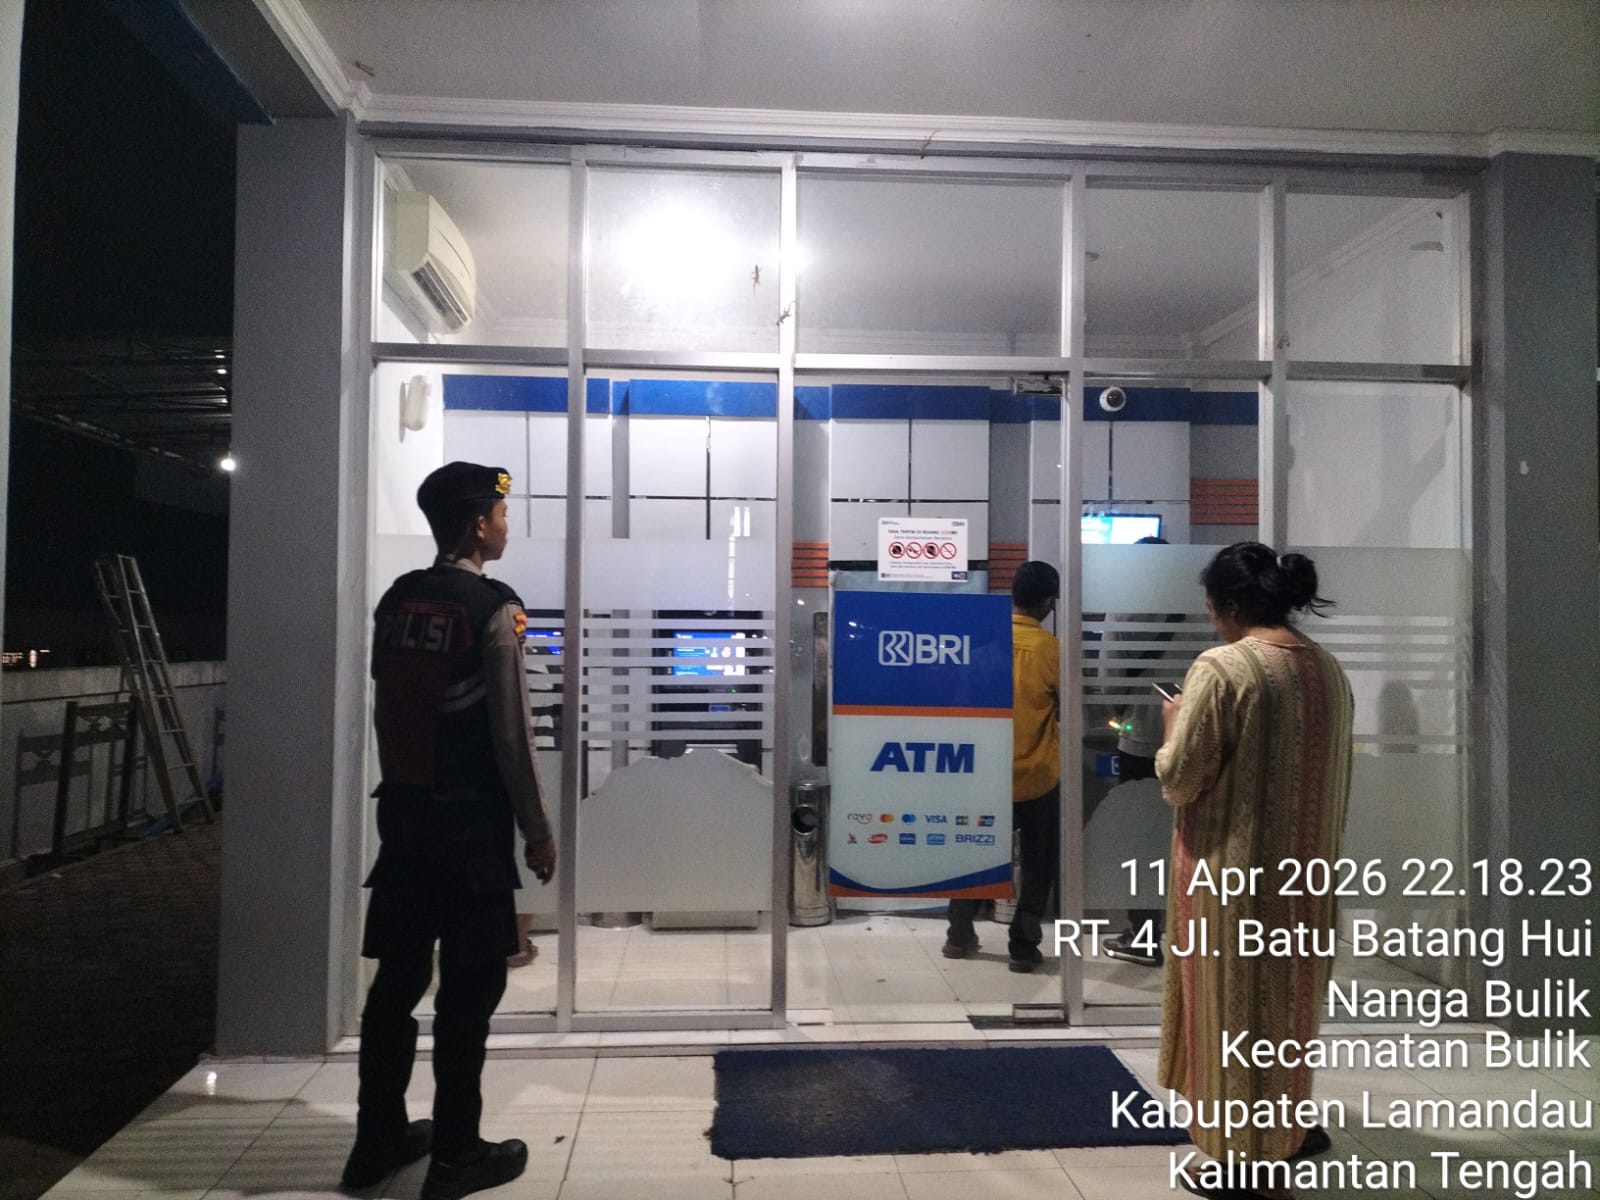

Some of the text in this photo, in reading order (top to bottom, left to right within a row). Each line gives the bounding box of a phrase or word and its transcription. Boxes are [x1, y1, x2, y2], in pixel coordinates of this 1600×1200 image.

[915, 633, 970, 665] BRI
[869, 741, 975, 774] ATM
[924, 814, 948, 824] VISA
[955, 833, 996, 846] BRIZZI
